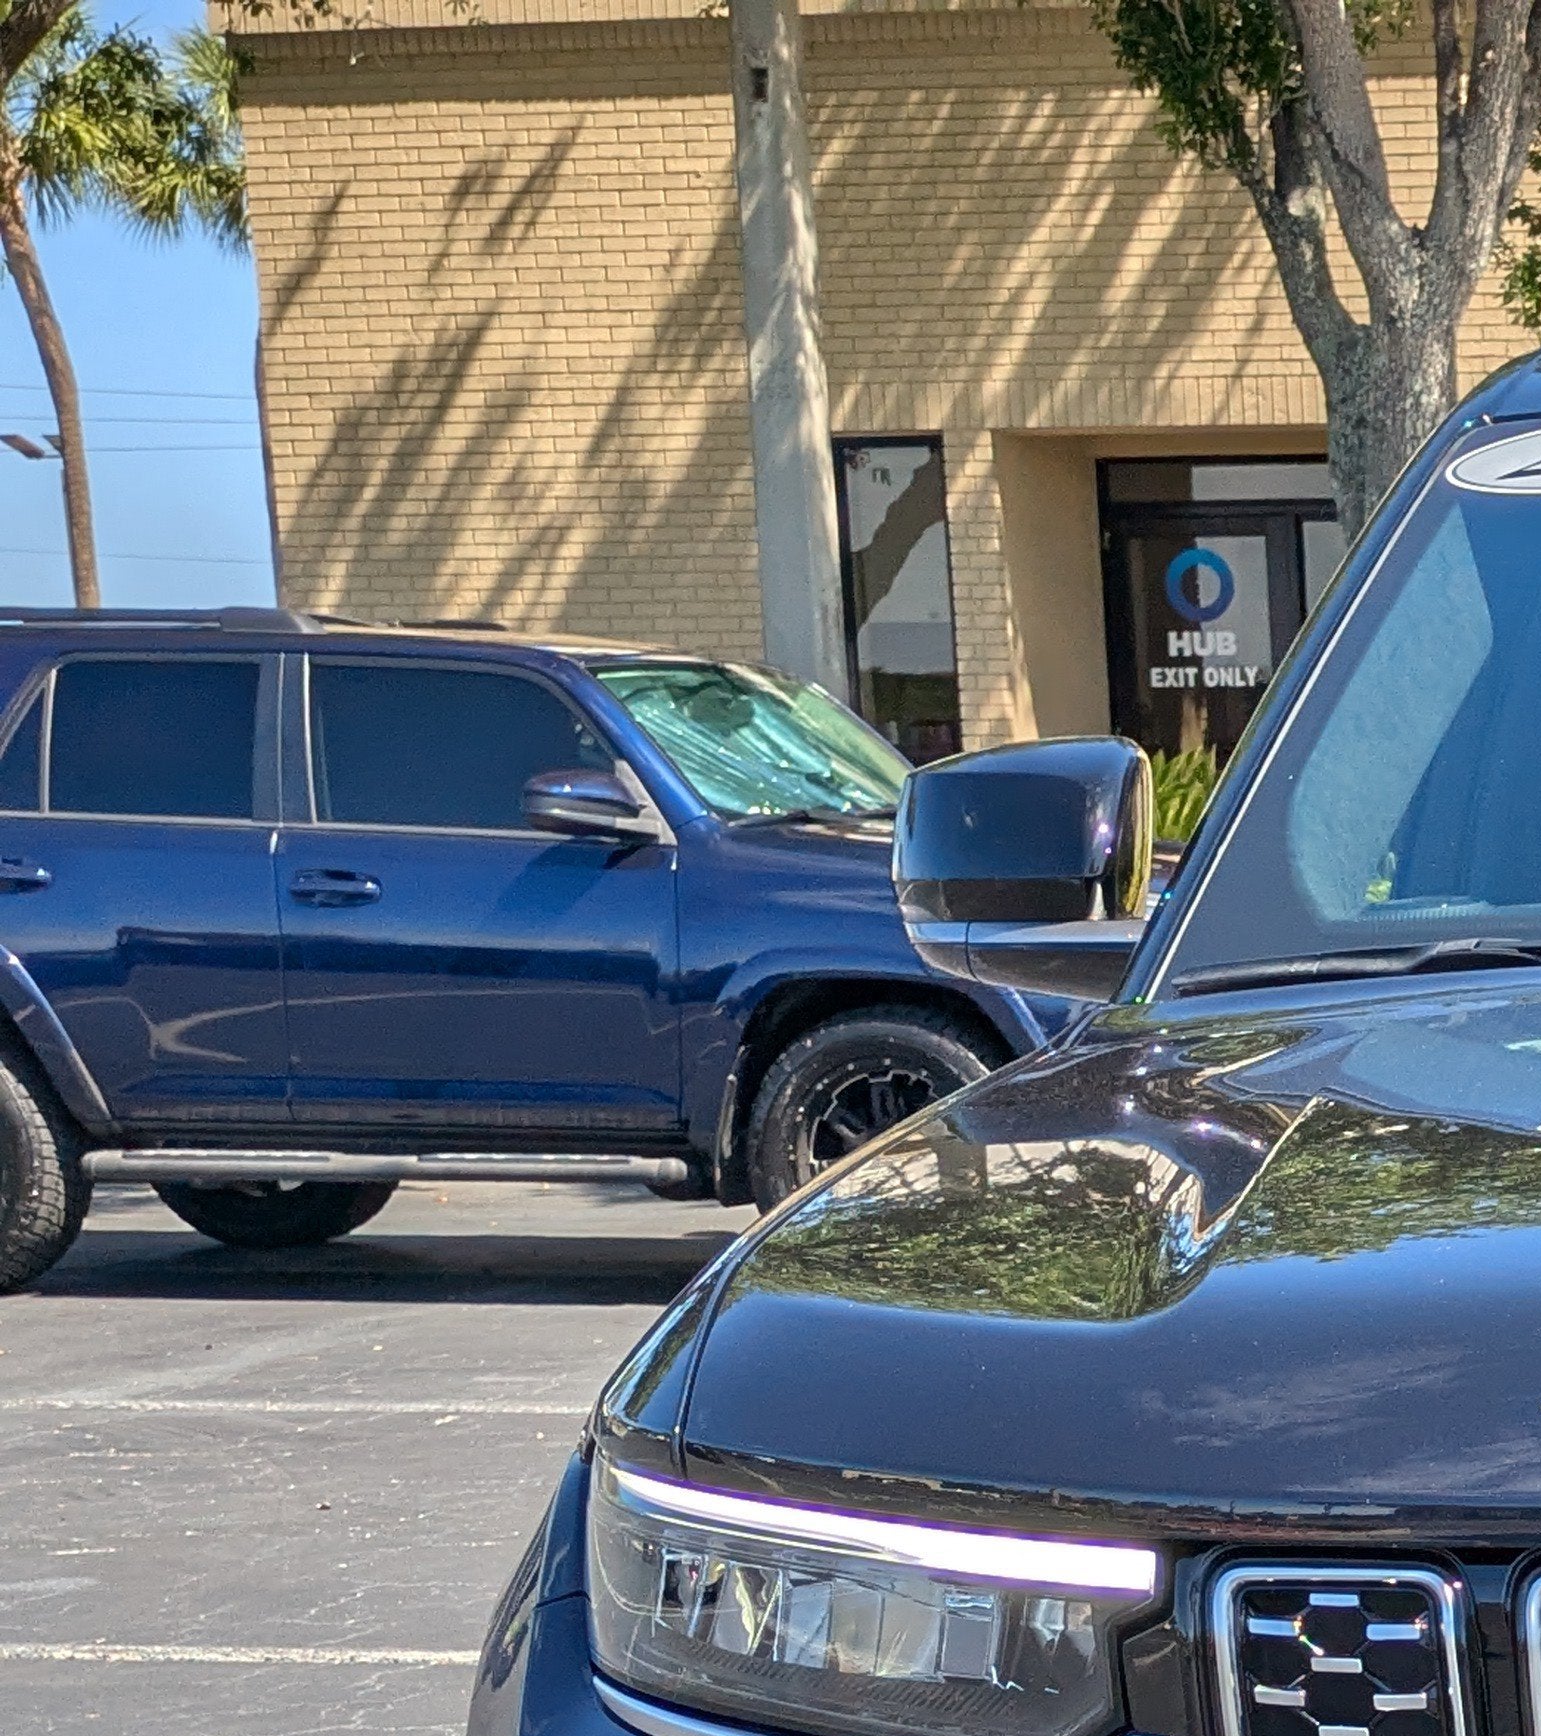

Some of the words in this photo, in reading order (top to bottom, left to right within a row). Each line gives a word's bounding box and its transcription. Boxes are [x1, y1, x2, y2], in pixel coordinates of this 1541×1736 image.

[1166, 630, 1238, 658] HUB
[1150, 667, 1198, 689] EXIT
[1203, 666, 1259, 688] ONLY
